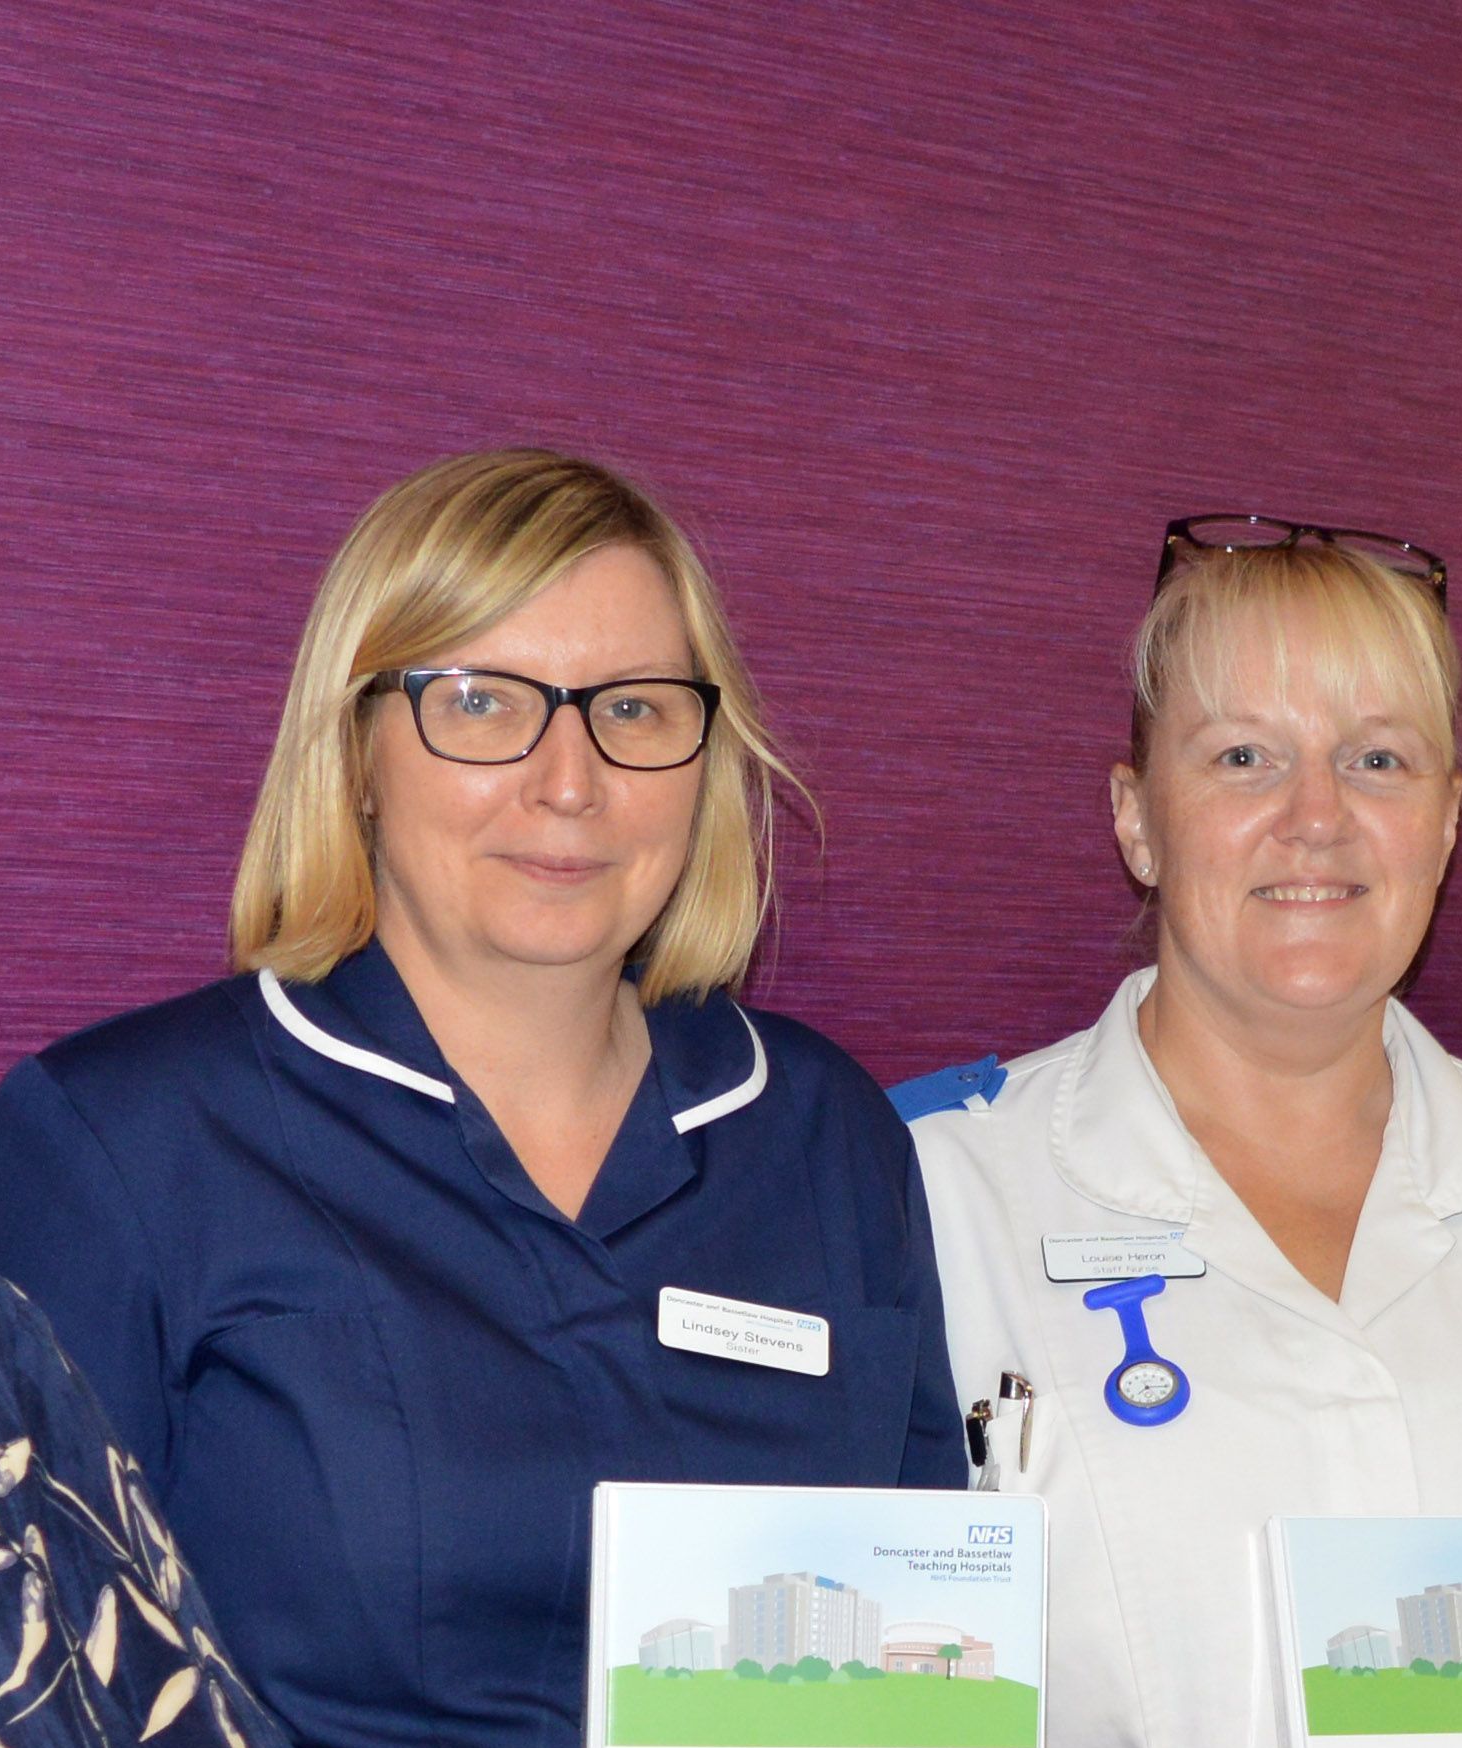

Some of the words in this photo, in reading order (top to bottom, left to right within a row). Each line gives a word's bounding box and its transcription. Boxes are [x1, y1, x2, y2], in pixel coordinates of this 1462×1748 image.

[1081, 1254, 1122, 1263] Louise
[1128, 1253, 1166, 1261] Heron
[682, 1319, 738, 1341] Lindsey
[744, 1331, 803, 1352] Stevens
[726, 1342, 759, 1355] Sister
[969, 1526, 1011, 1544] NHS
[873, 1546, 930, 1558] Doncaster
[932, 1548, 954, 1558] and
[957, 1548, 1012, 1559] Bassetlaw
[908, 1560, 957, 1574] Teaching
[960, 1561, 1012, 1574] Hospitals
